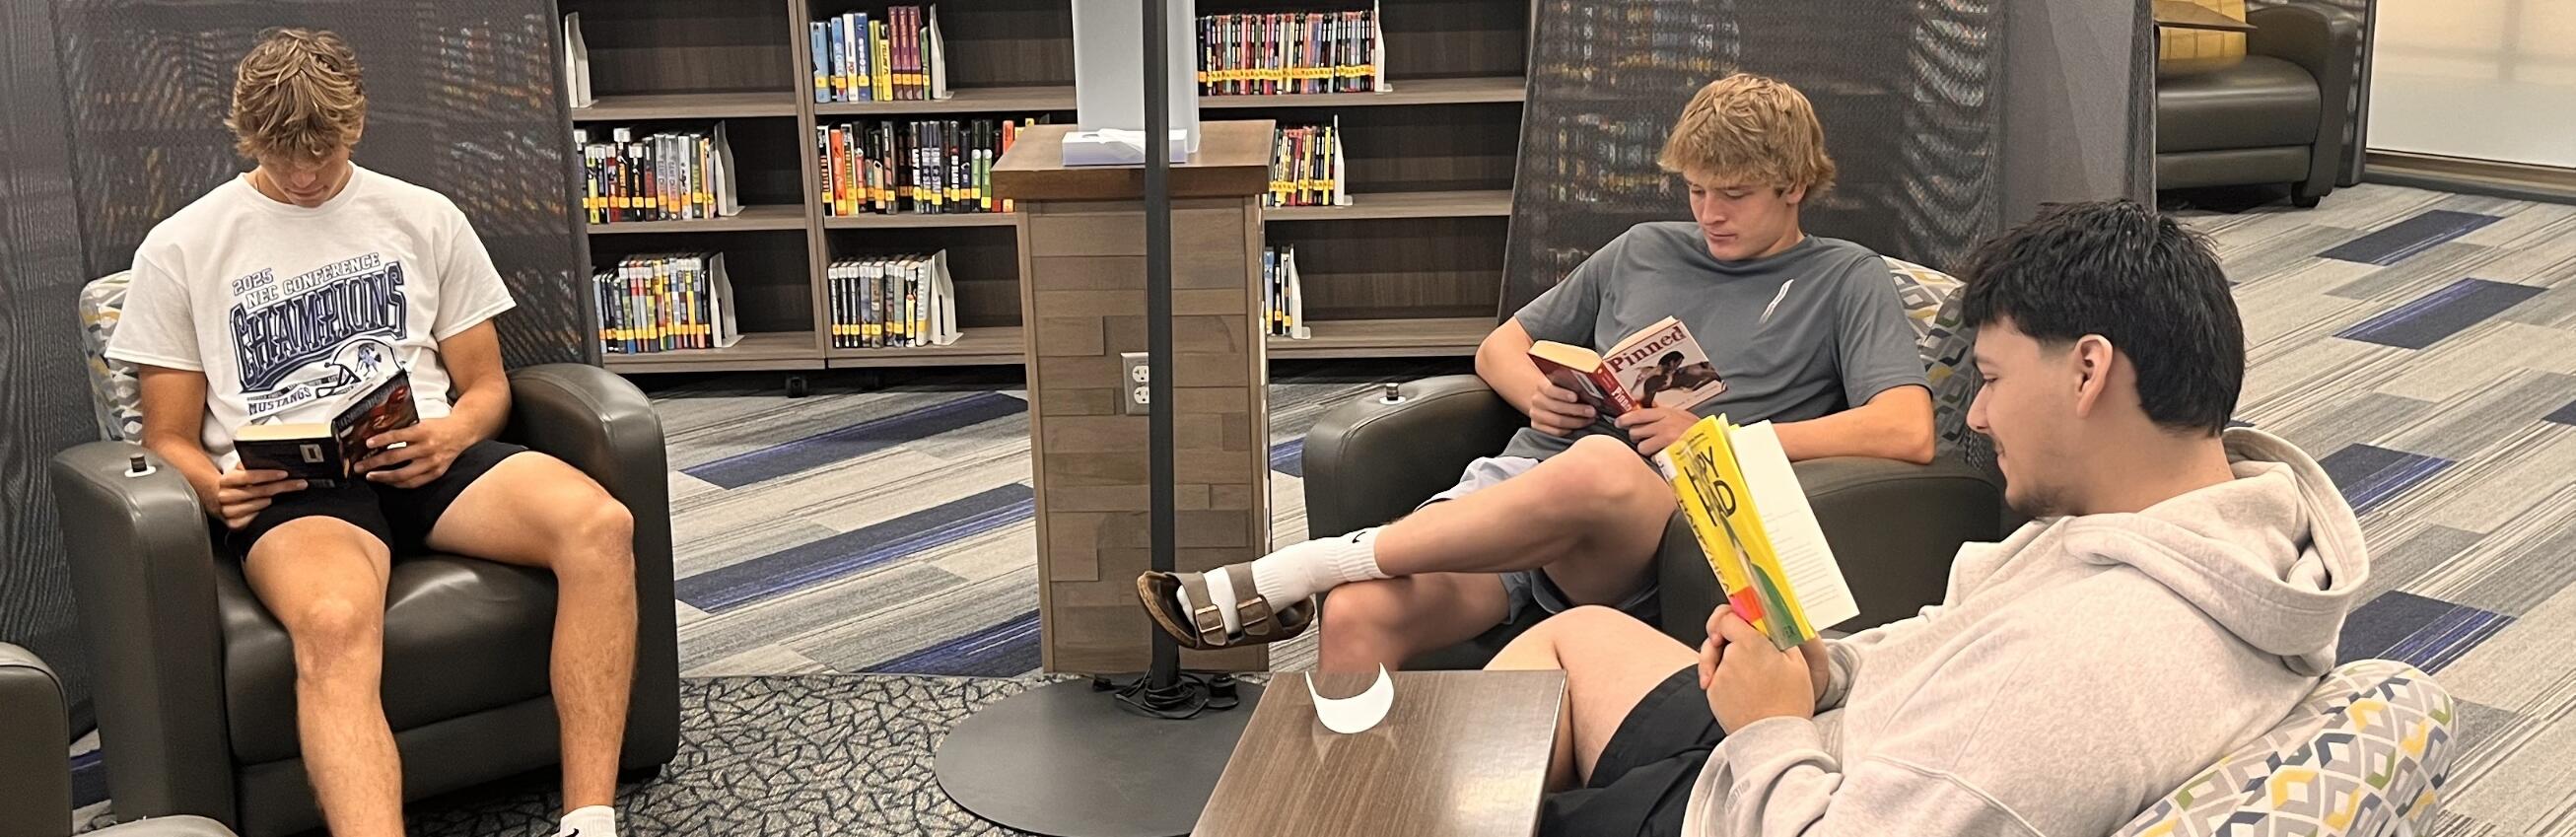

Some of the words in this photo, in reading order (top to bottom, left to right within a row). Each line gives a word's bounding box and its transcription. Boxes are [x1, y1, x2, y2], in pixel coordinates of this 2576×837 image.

[232, 268, 274, 297] 2025
[246, 285, 279, 310] NEC
[283, 252, 382, 295] CONFERENCE
[230, 260, 407, 392] CHAMPIONS
[1607, 326, 1687, 373] Pinned
[247, 385, 313, 416] MUSTANGS
